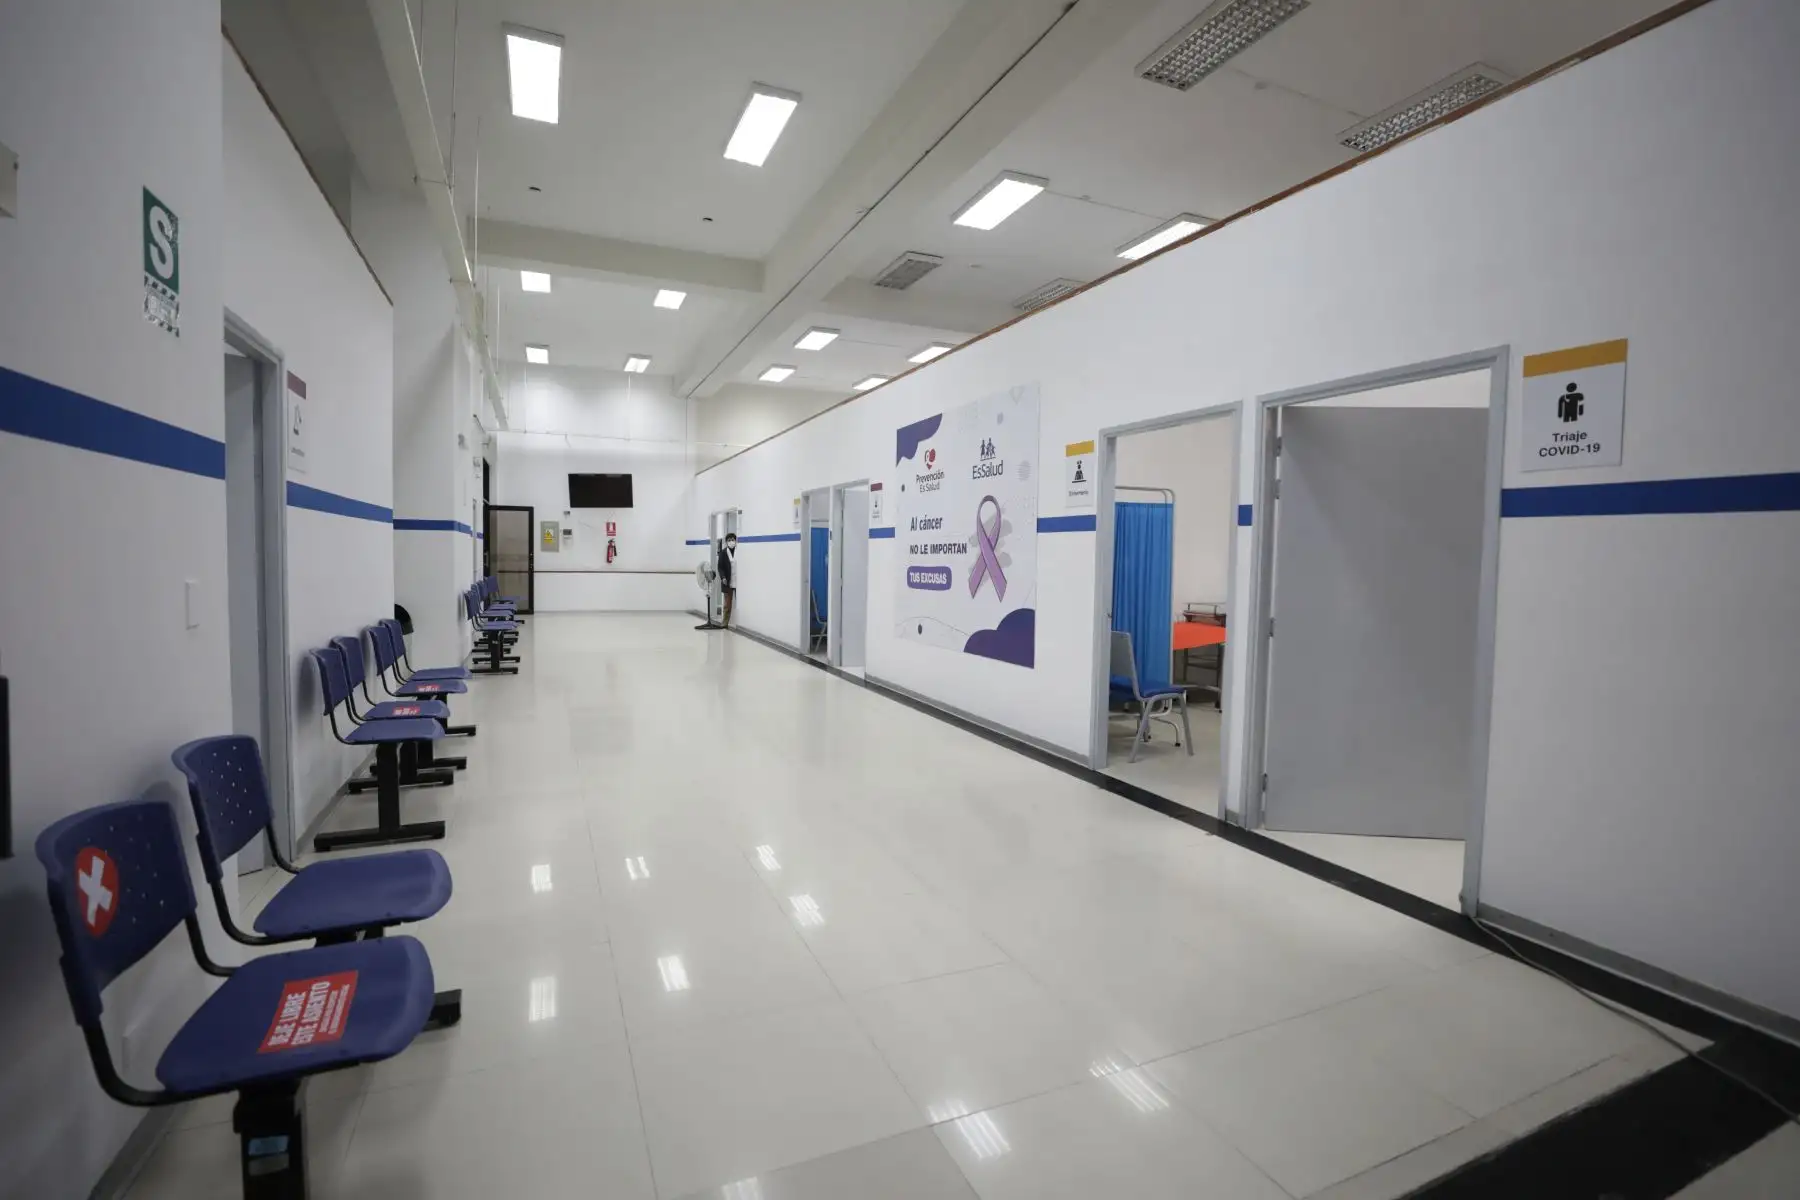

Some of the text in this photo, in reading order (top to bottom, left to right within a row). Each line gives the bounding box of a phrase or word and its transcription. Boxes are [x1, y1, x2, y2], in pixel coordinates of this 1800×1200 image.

[149, 205, 174, 280] S
[1552, 430, 1588, 443] Triaje
[1539, 442, 1601, 457] COVID-19
[916, 469, 945, 484] Prevención
[972, 460, 1004, 480] EsSalud
[910, 514, 943, 531] Al cáncer
[910, 543, 967, 554] NO LE IMPORTAN
[909, 572, 947, 584] TUS EXCUSAS
